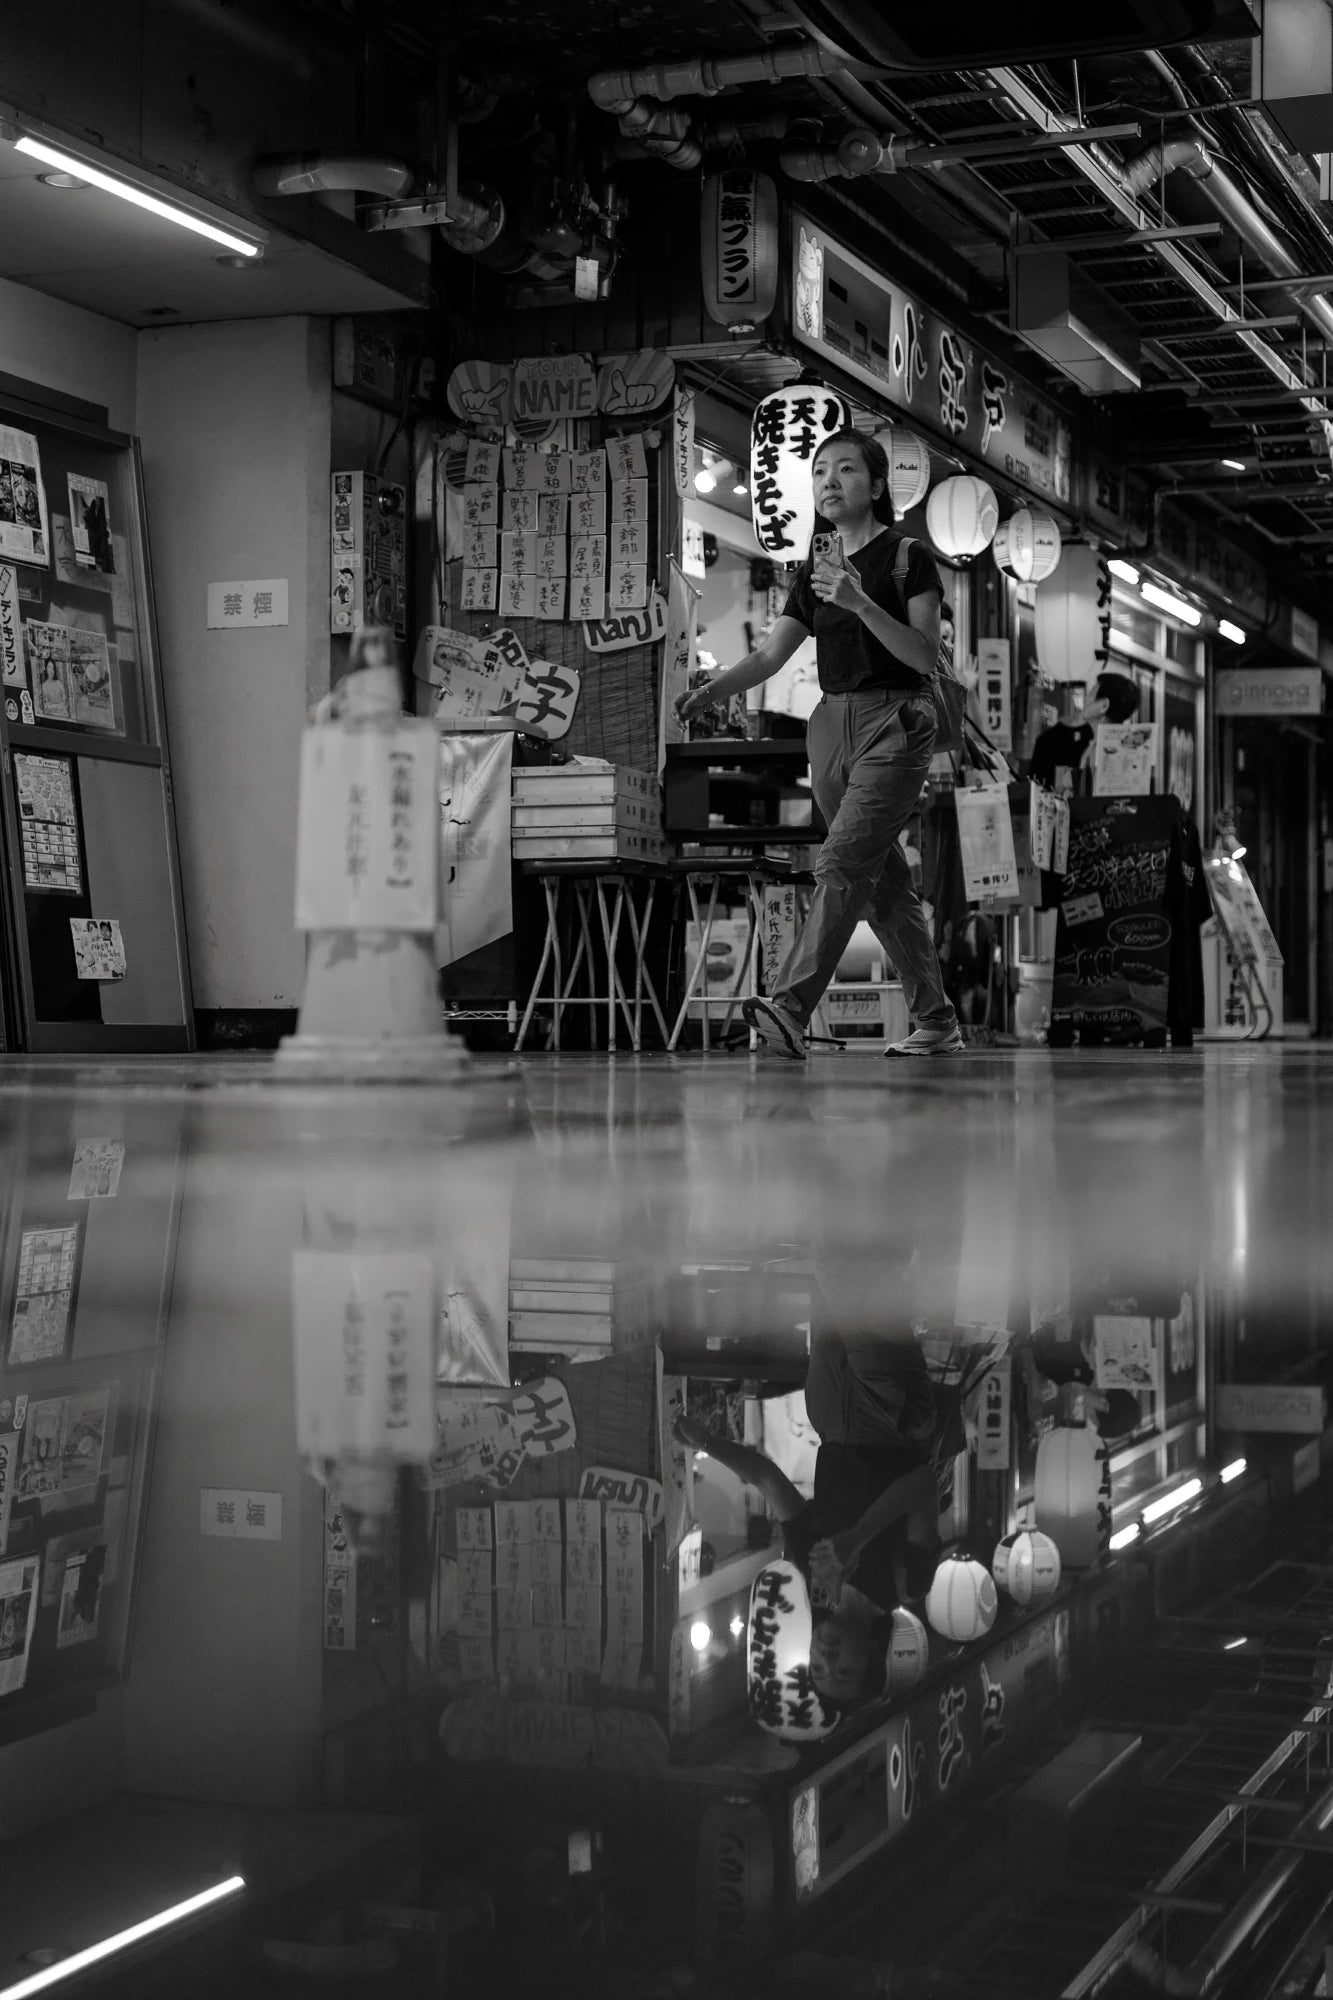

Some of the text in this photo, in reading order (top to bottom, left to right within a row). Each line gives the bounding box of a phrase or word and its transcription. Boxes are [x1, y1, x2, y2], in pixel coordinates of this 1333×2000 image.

[521, 356, 581, 378] YOUR
[519, 377, 592, 415] NAME
[788, 397, 817, 459] 天才
[754, 398, 797, 551] 焼きそば
[224, 591, 272, 618] 禁煙
[587, 602, 663, 646] Kanji
[986, 670, 1003, 731] 一番搾り
